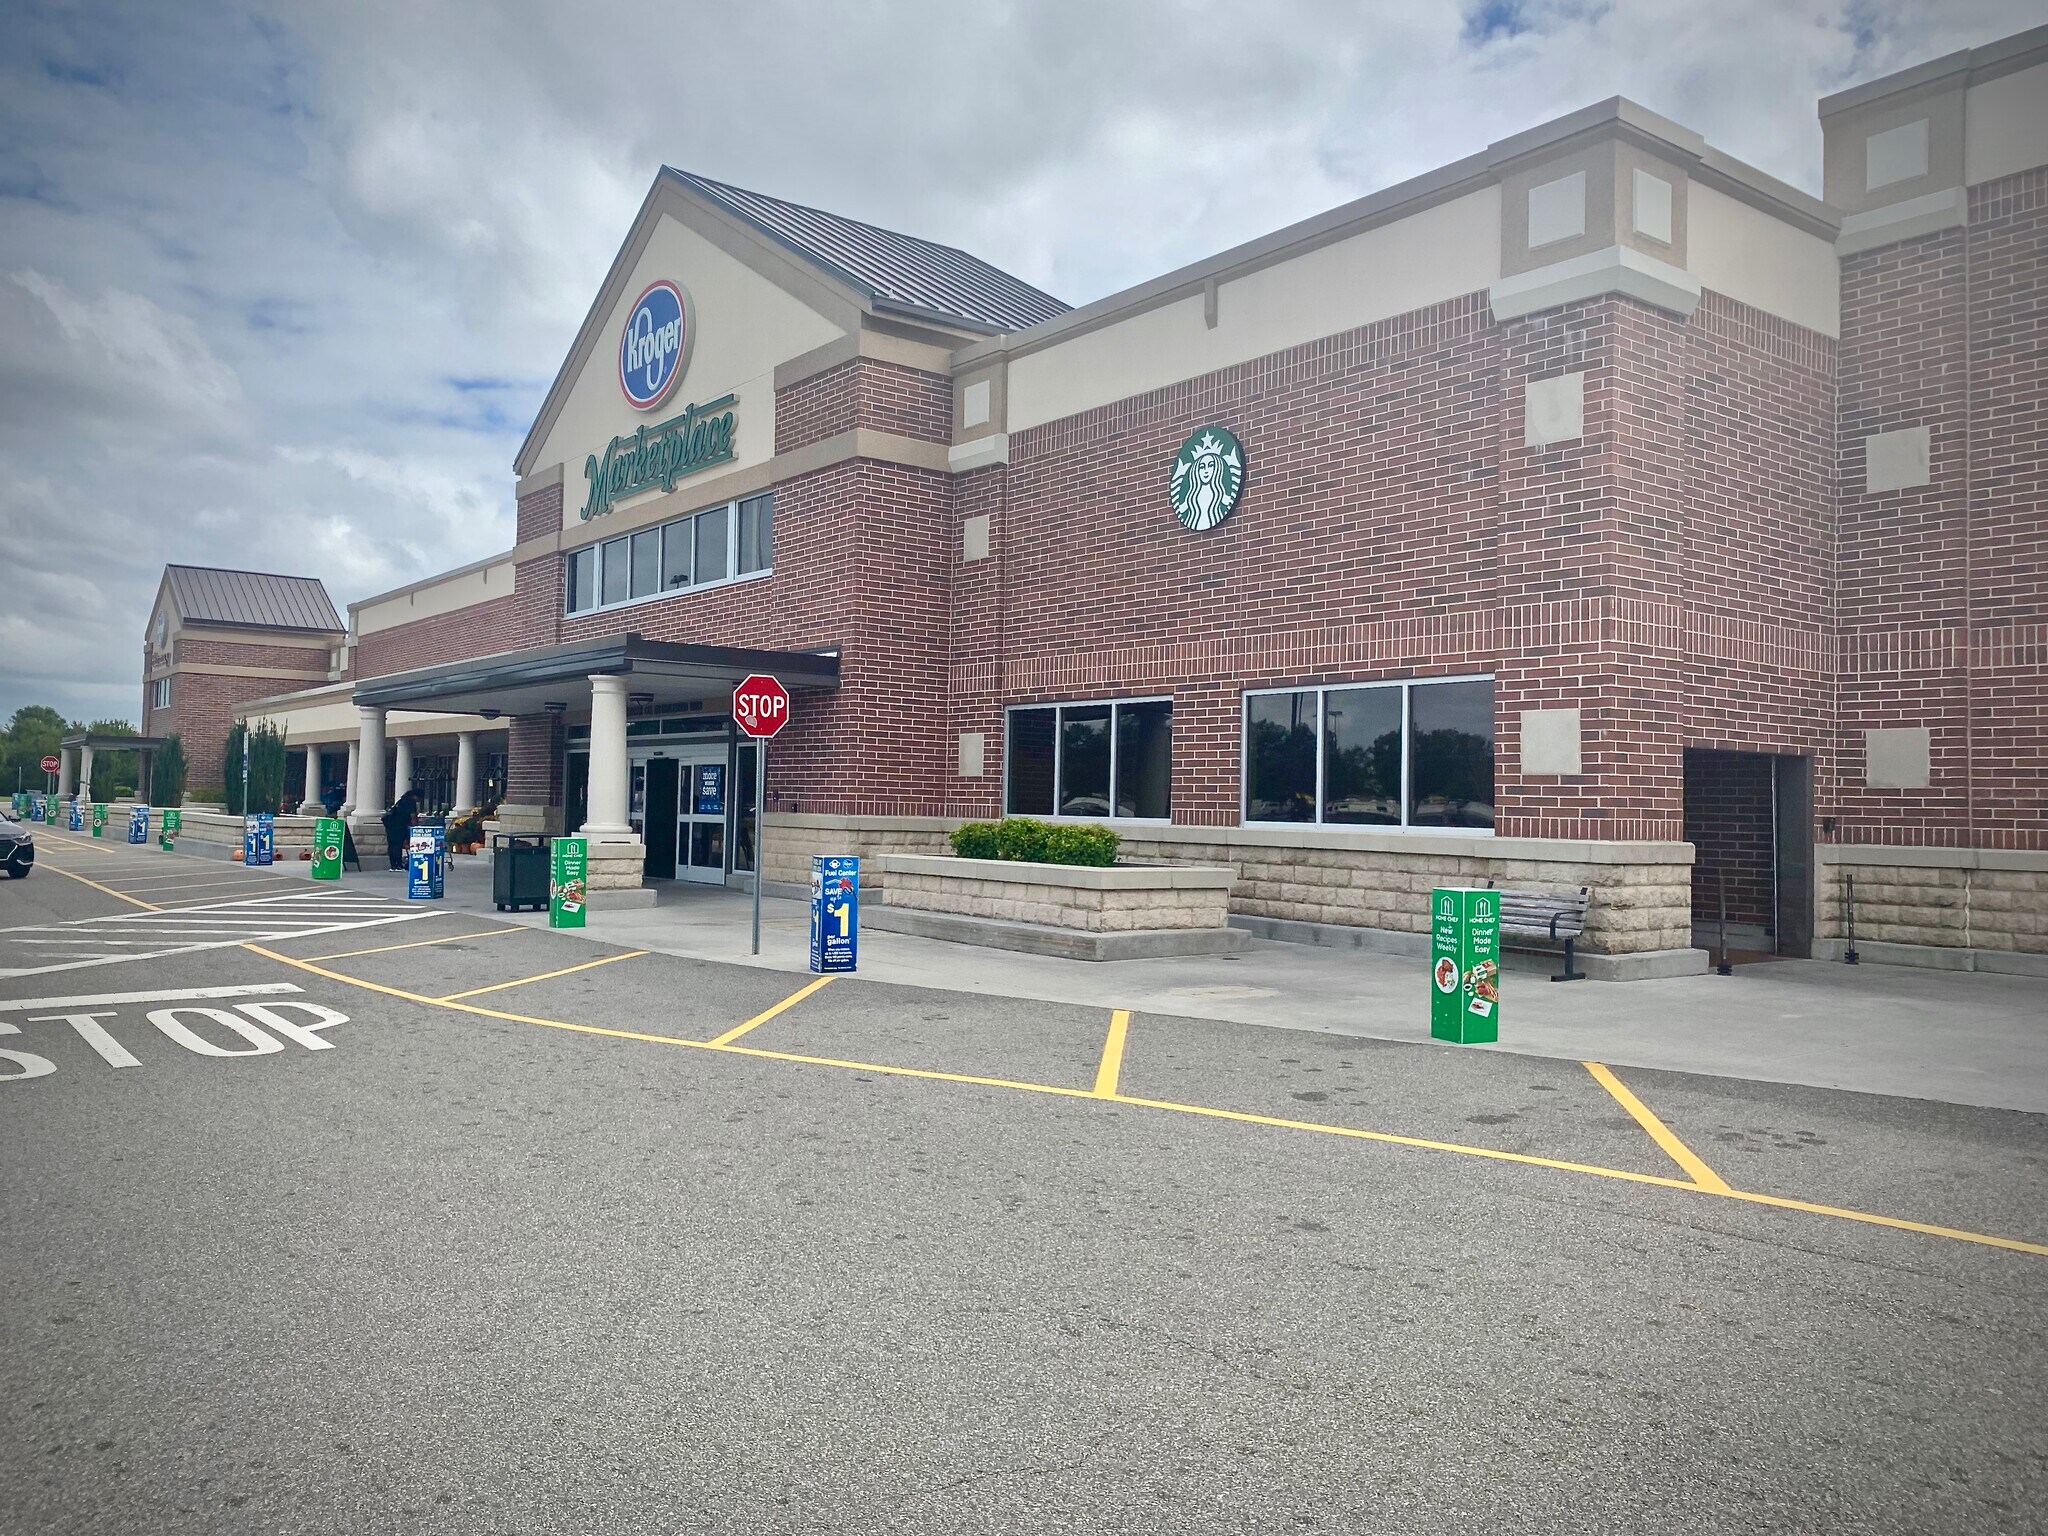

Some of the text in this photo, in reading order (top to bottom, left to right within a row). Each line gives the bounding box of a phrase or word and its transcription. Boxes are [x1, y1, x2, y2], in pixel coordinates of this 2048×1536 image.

[627, 307, 681, 391] Kroger
[580, 403, 735, 521] Marketplace
[738, 694, 785, 717] STOP
[825, 888, 843, 896] SAVE
[1440, 926, 1453, 934] New
[1472, 928, 1494, 936] Dinner
[1436, 934, 1458, 944] Recipes
[1436, 942, 1458, 955] Weekly
[1474, 946, 1490, 955] Easy
